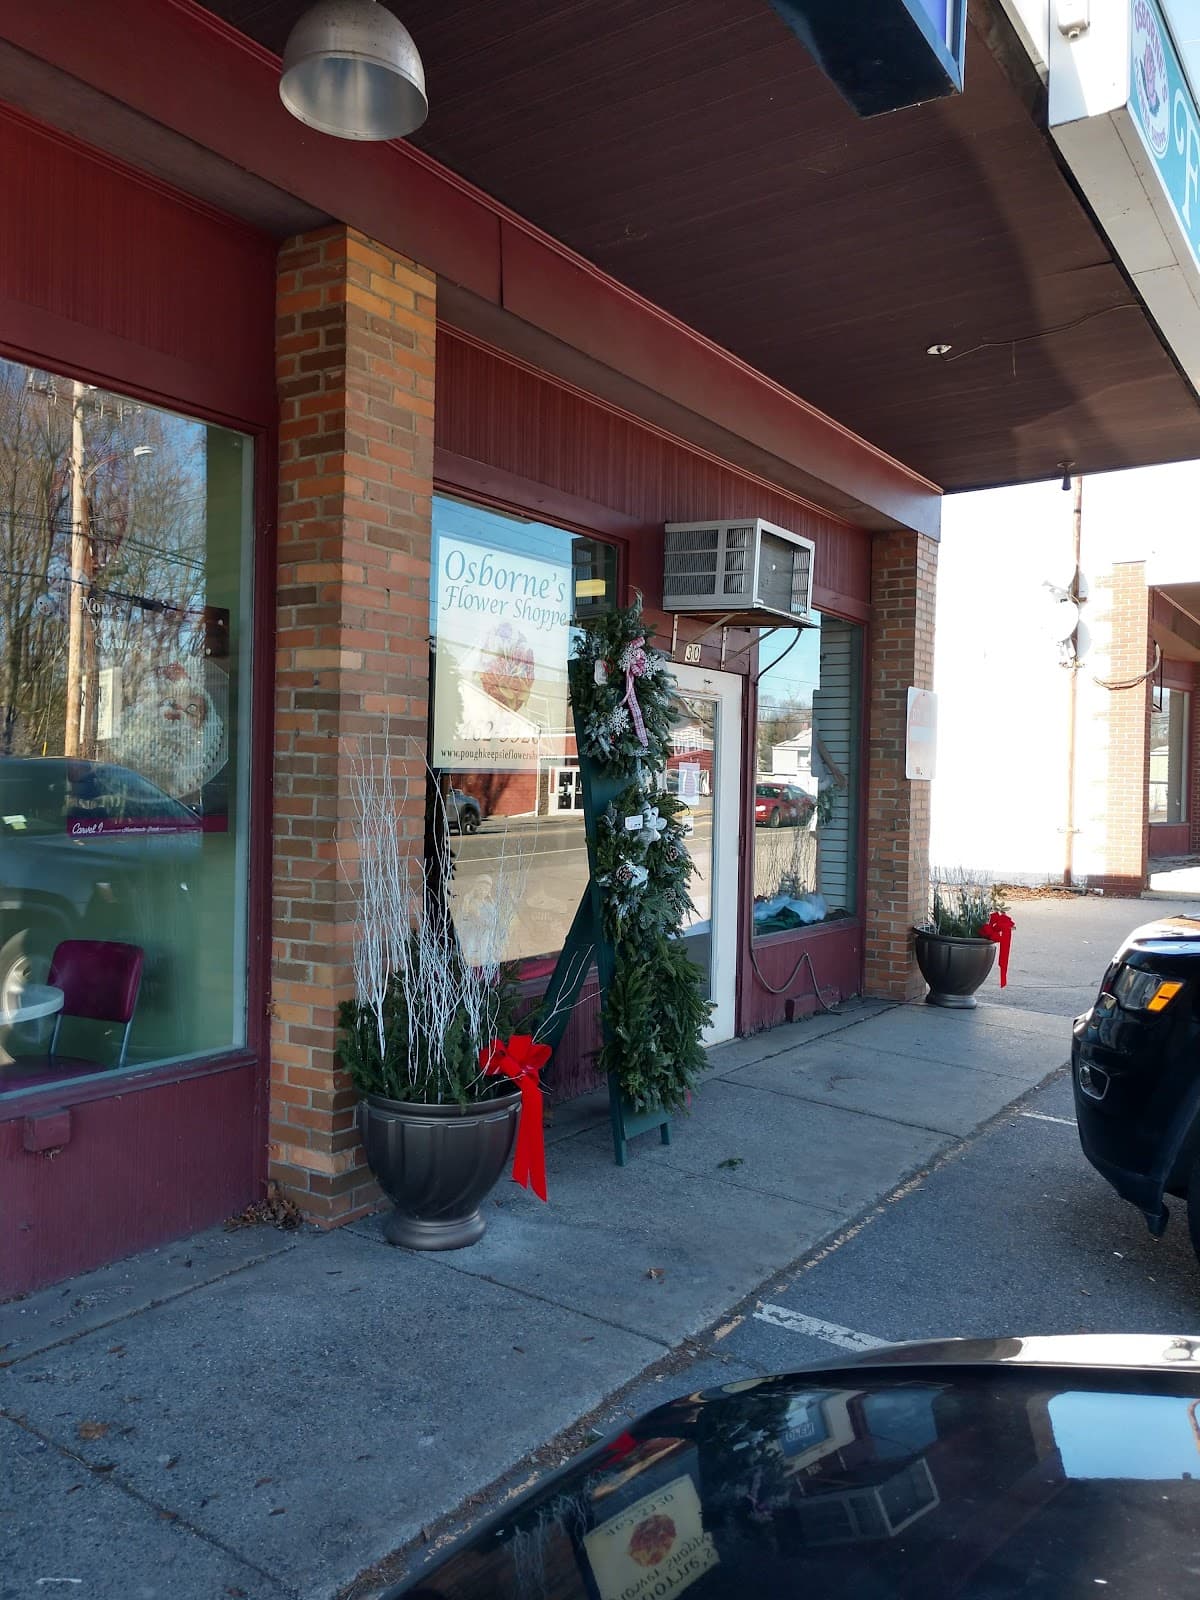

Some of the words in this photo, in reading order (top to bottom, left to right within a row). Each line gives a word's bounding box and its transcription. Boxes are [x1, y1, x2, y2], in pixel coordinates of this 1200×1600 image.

[445, 550, 566, 603] Osborne's
[442, 585, 509, 616] Flower
[513, 598, 567, 632] Shoppe
[686, 645, 700, 661] 30
[72, 823, 97, 834] Carvel
